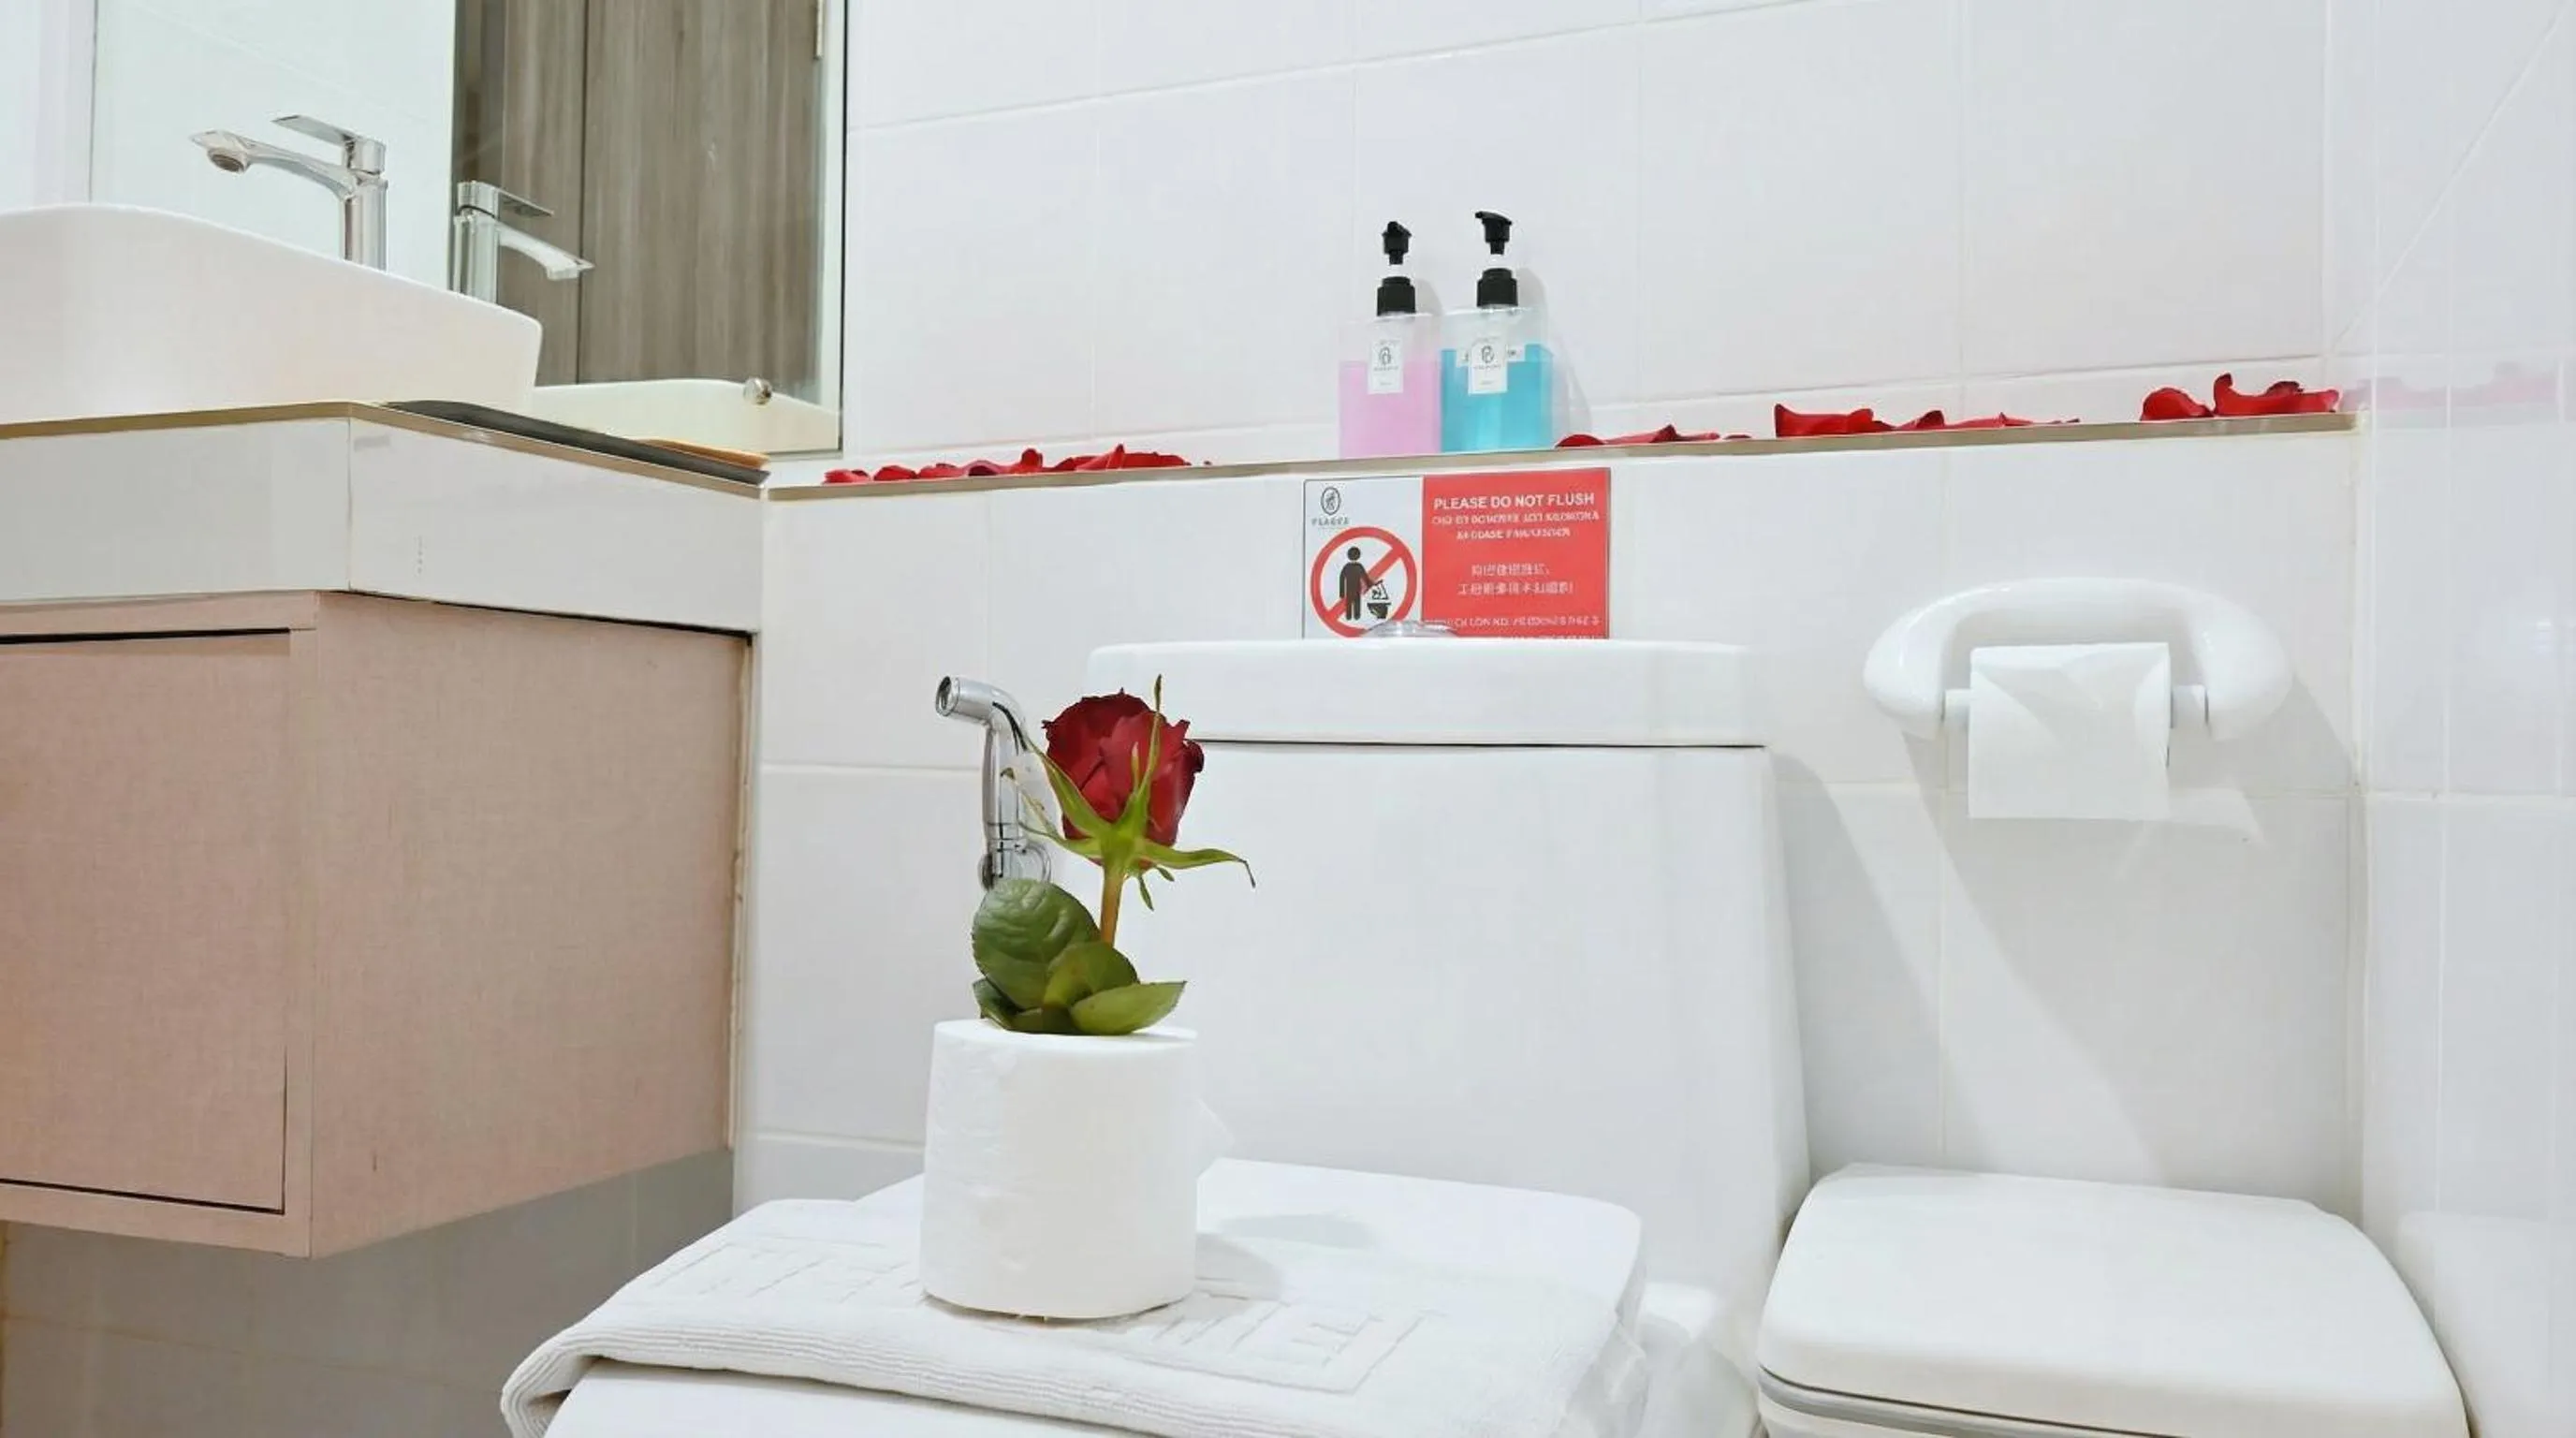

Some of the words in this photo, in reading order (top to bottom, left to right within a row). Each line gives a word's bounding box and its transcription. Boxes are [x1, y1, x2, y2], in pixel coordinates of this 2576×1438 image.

[1433, 496, 1487, 510] PLEASE
[1491, 495, 1512, 508] DO
[1515, 493, 1544, 507] NOT
[1546, 492, 1595, 506] FLUSH
